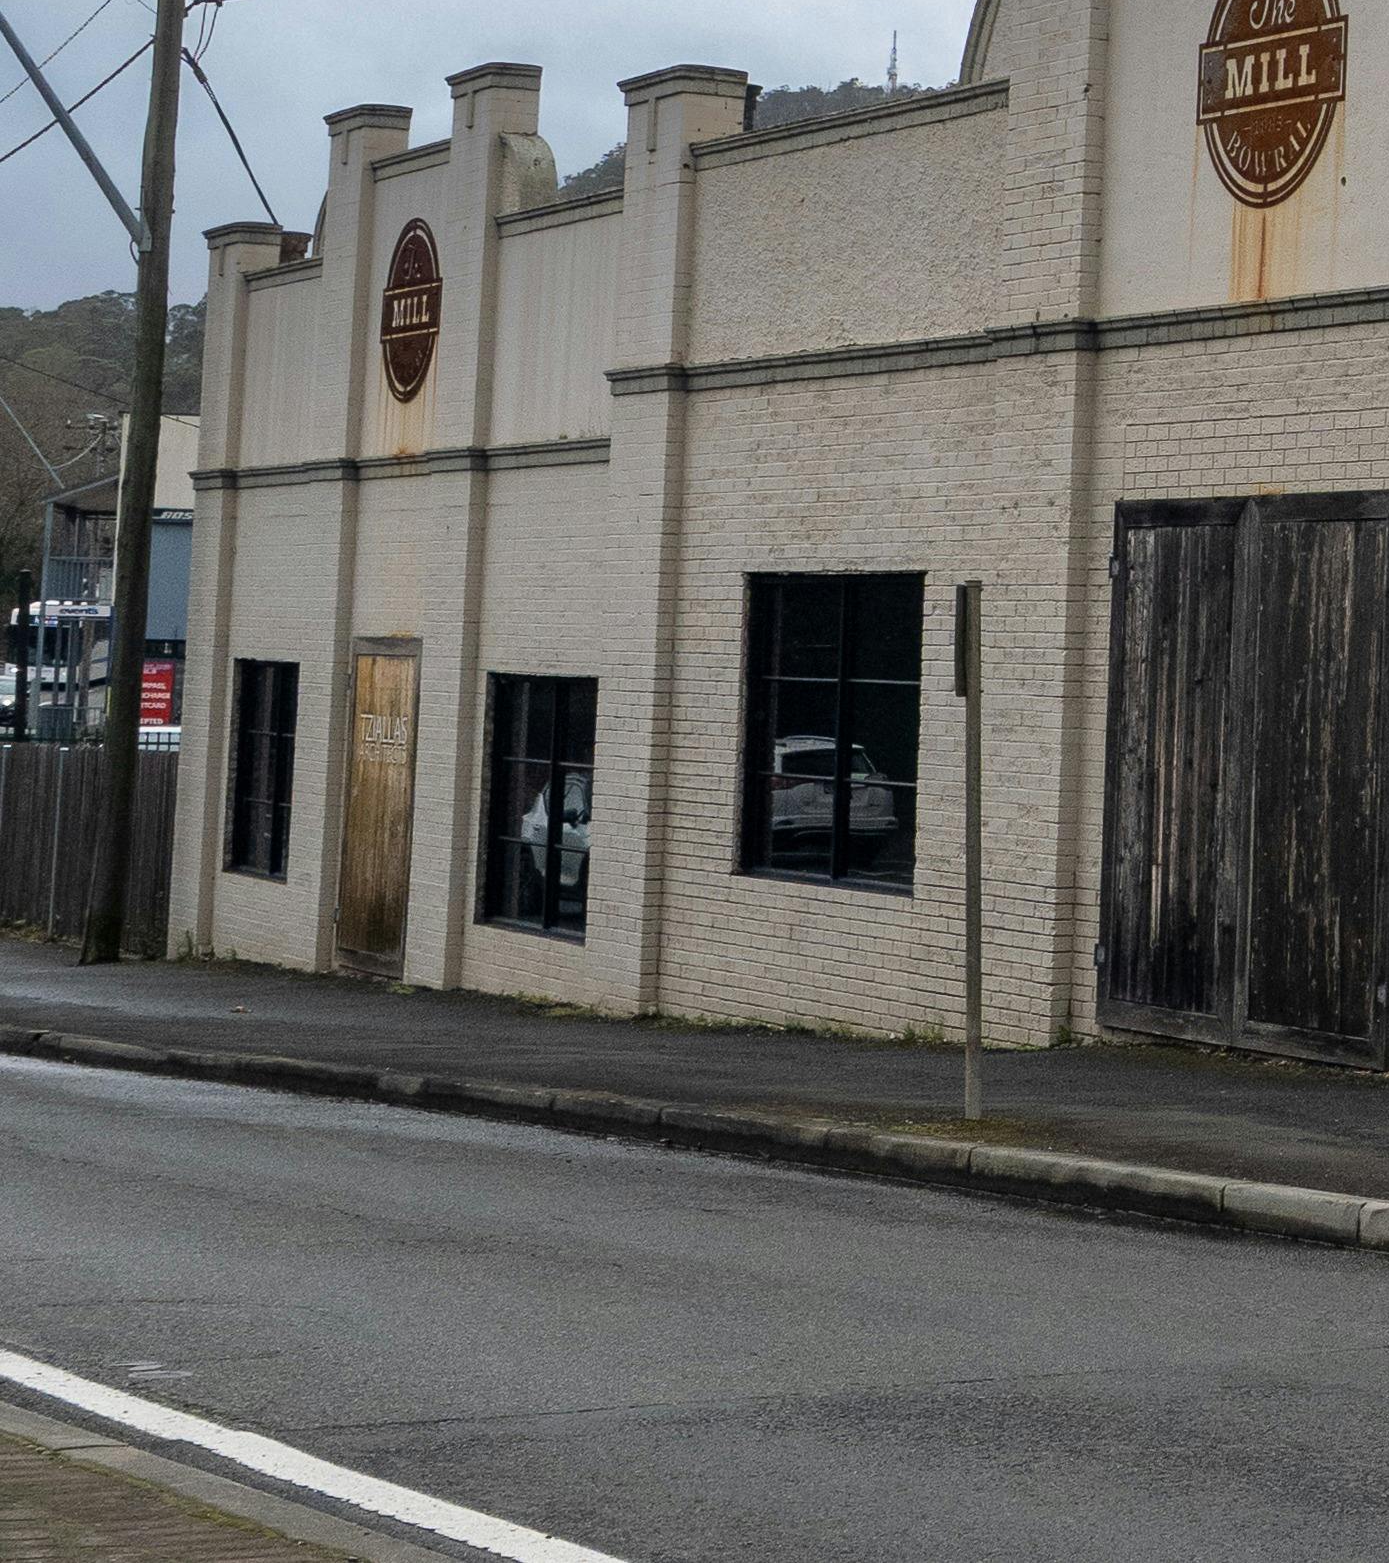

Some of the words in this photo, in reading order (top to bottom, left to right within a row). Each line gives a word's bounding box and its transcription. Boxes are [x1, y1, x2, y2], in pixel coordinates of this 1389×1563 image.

[1224, 44, 1317, 100] MILL
[1226, 120, 1311, 177] BOWRAL
[392, 295, 430, 328] MILL
[59, 607, 99, 615] events
